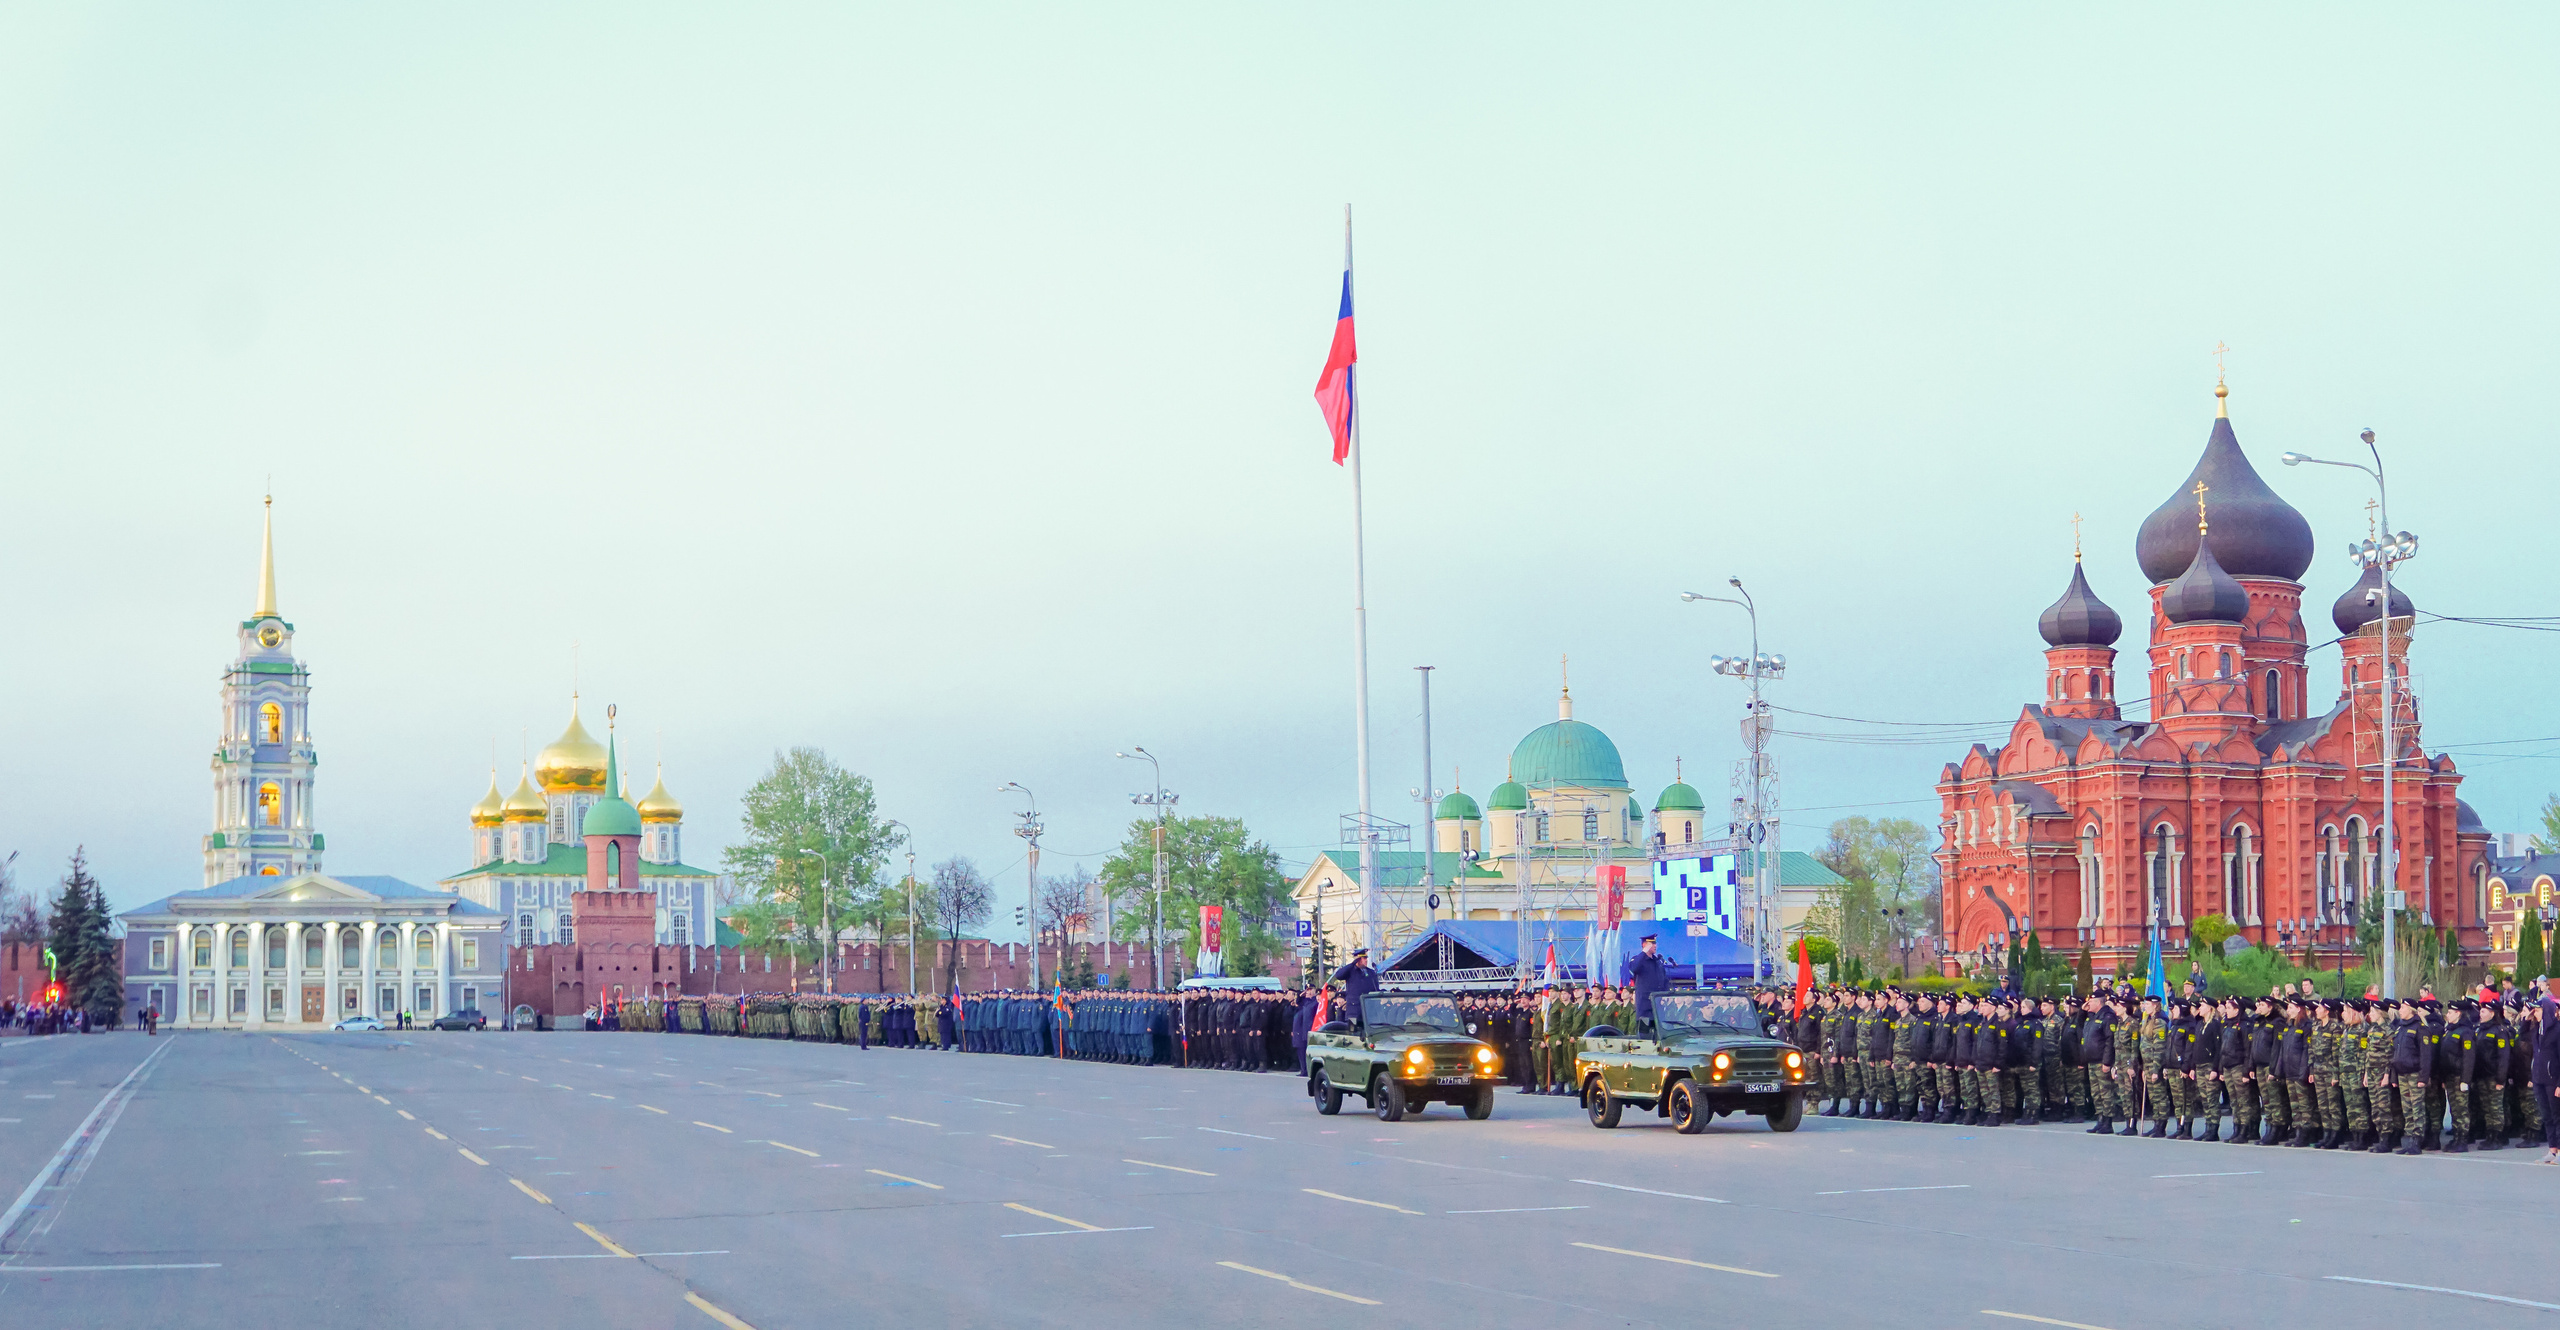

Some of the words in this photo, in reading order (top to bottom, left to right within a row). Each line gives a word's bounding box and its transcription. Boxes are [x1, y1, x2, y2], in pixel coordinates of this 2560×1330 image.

[1692, 889, 1702, 907] P
[1600, 903, 1606, 917] 9
[1614, 903, 1620, 917] 9
[1300, 922, 1308, 936] P
[1211, 933, 1217, 942] 9
